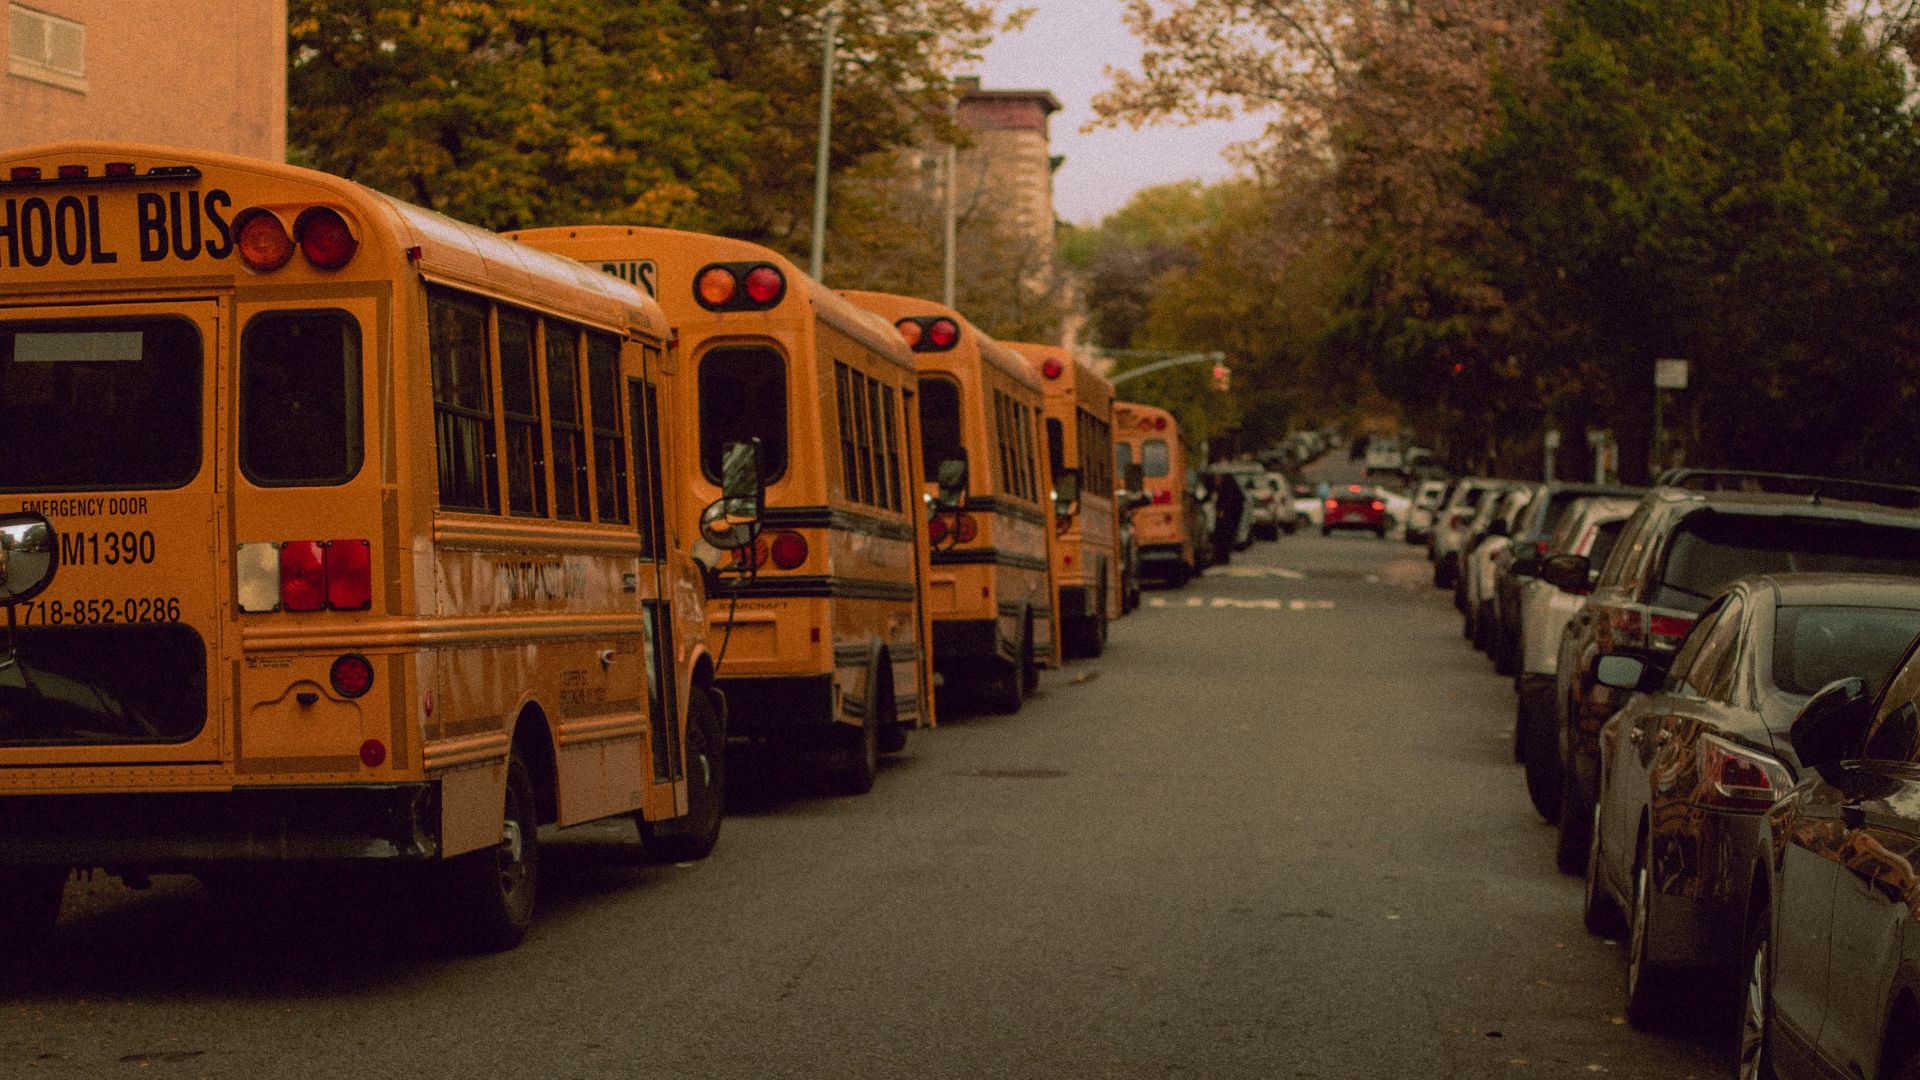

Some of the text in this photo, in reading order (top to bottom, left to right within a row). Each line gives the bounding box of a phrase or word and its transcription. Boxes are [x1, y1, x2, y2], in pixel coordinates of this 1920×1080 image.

[137, 188, 234, 262] BUS
[22, 497, 147, 517] EMERGENCY DOOR
[62, 530, 156, 565] M1390
[22, 597, 181, 625] 718-852-0286
